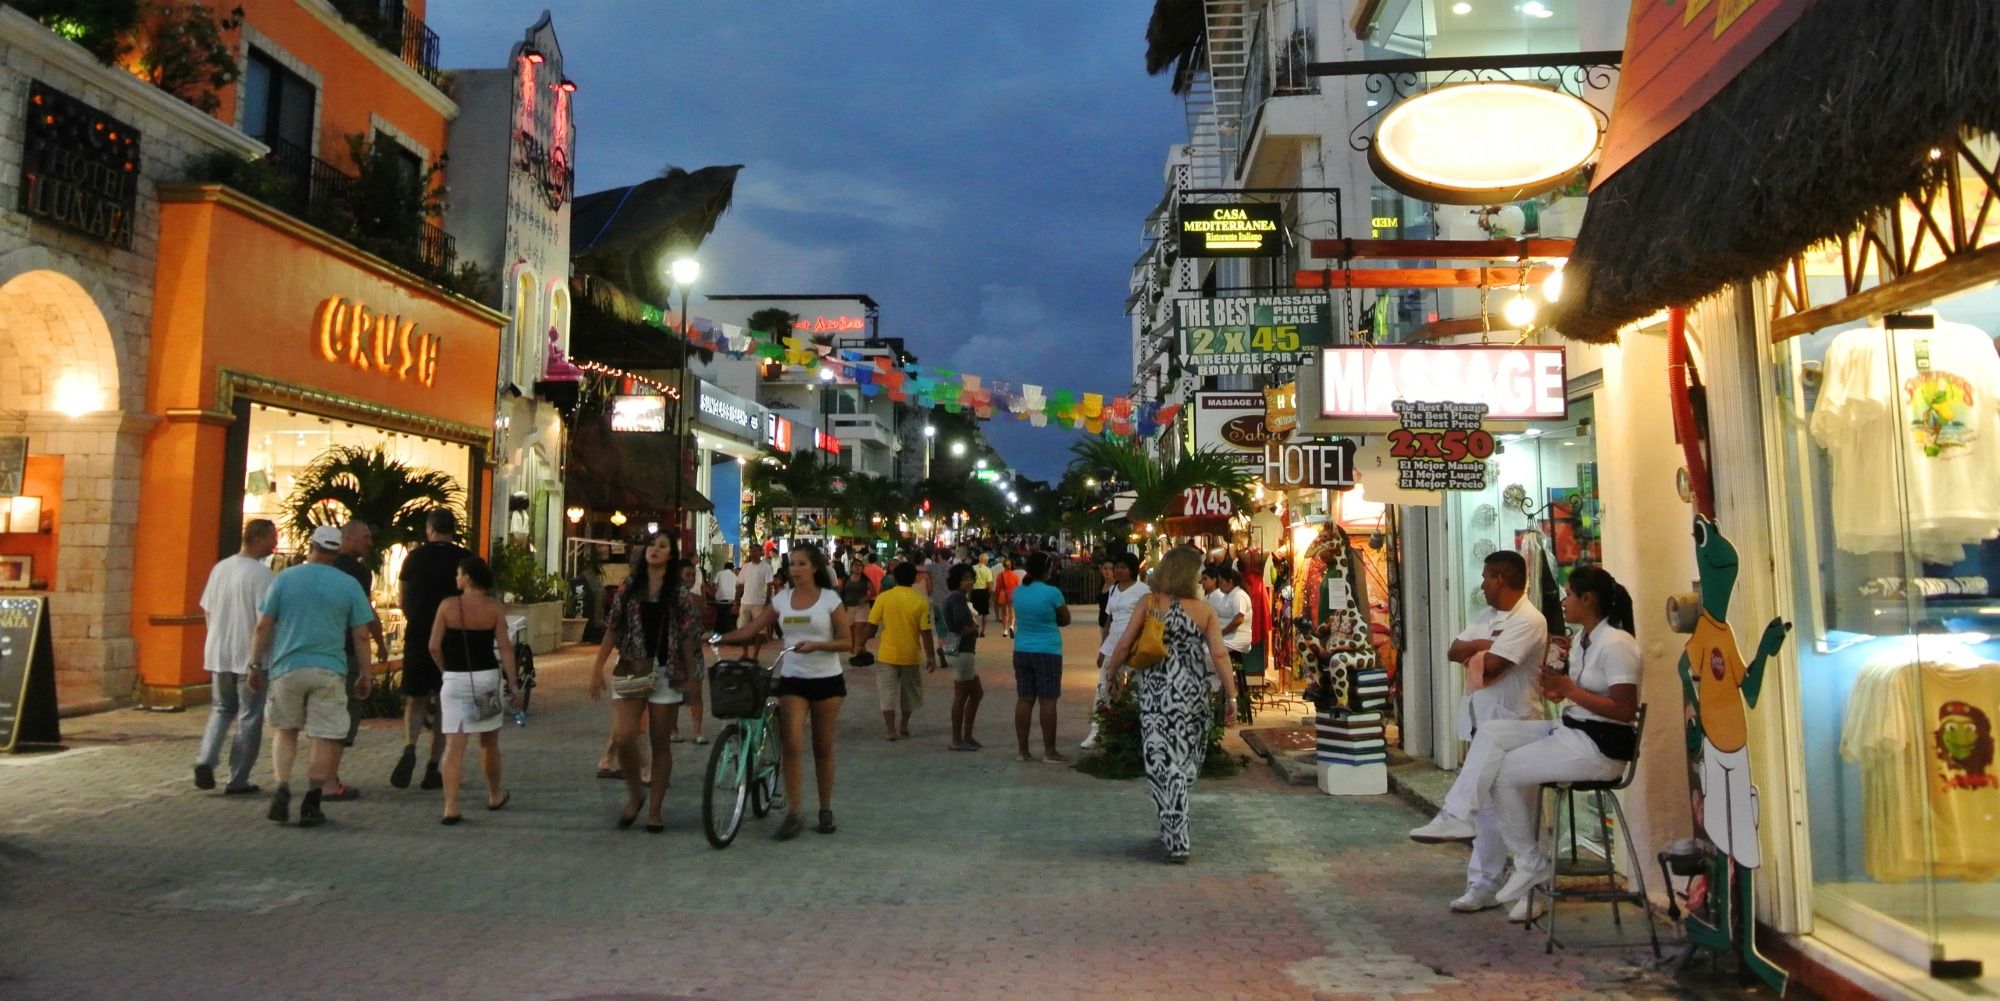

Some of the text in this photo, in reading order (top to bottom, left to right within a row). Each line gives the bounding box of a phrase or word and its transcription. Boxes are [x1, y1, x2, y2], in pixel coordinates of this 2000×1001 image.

[1213, 208, 1248, 220] CASA
[1184, 220, 1277, 231] MEDITERRANEA
[1178, 298, 1210, 328] THE
[1214, 297, 1257, 327] BEST
[1273, 305, 1317, 315] PRICE
[1273, 315, 1318, 324] PLACE
[320, 294, 441, 388] CRUSH
[1192, 328, 1215, 355] 2
[1251, 325, 1300, 352] 45
[1189, 355, 1200, 365] A
[1203, 354, 1259, 365] REFUGE
[1263, 352, 1292, 364] FOR
[1198, 365, 1239, 376] BODY
[1323, 350, 1564, 414] MASSAGE
[1394, 402, 1487, 413] The Best Massage
[1401, 411, 1480, 420] The Best Place
[1402, 420, 1480, 428] The Best Price
[1264, 444, 1354, 486] HOTEL
[1400, 461, 1485, 473] El Mejor Masaje
[1402, 470, 1482, 482] El Mejor Lugar
[1401, 479, 1484, 491] El Mejor Precio
[1183, 487, 1232, 515] 2X45
